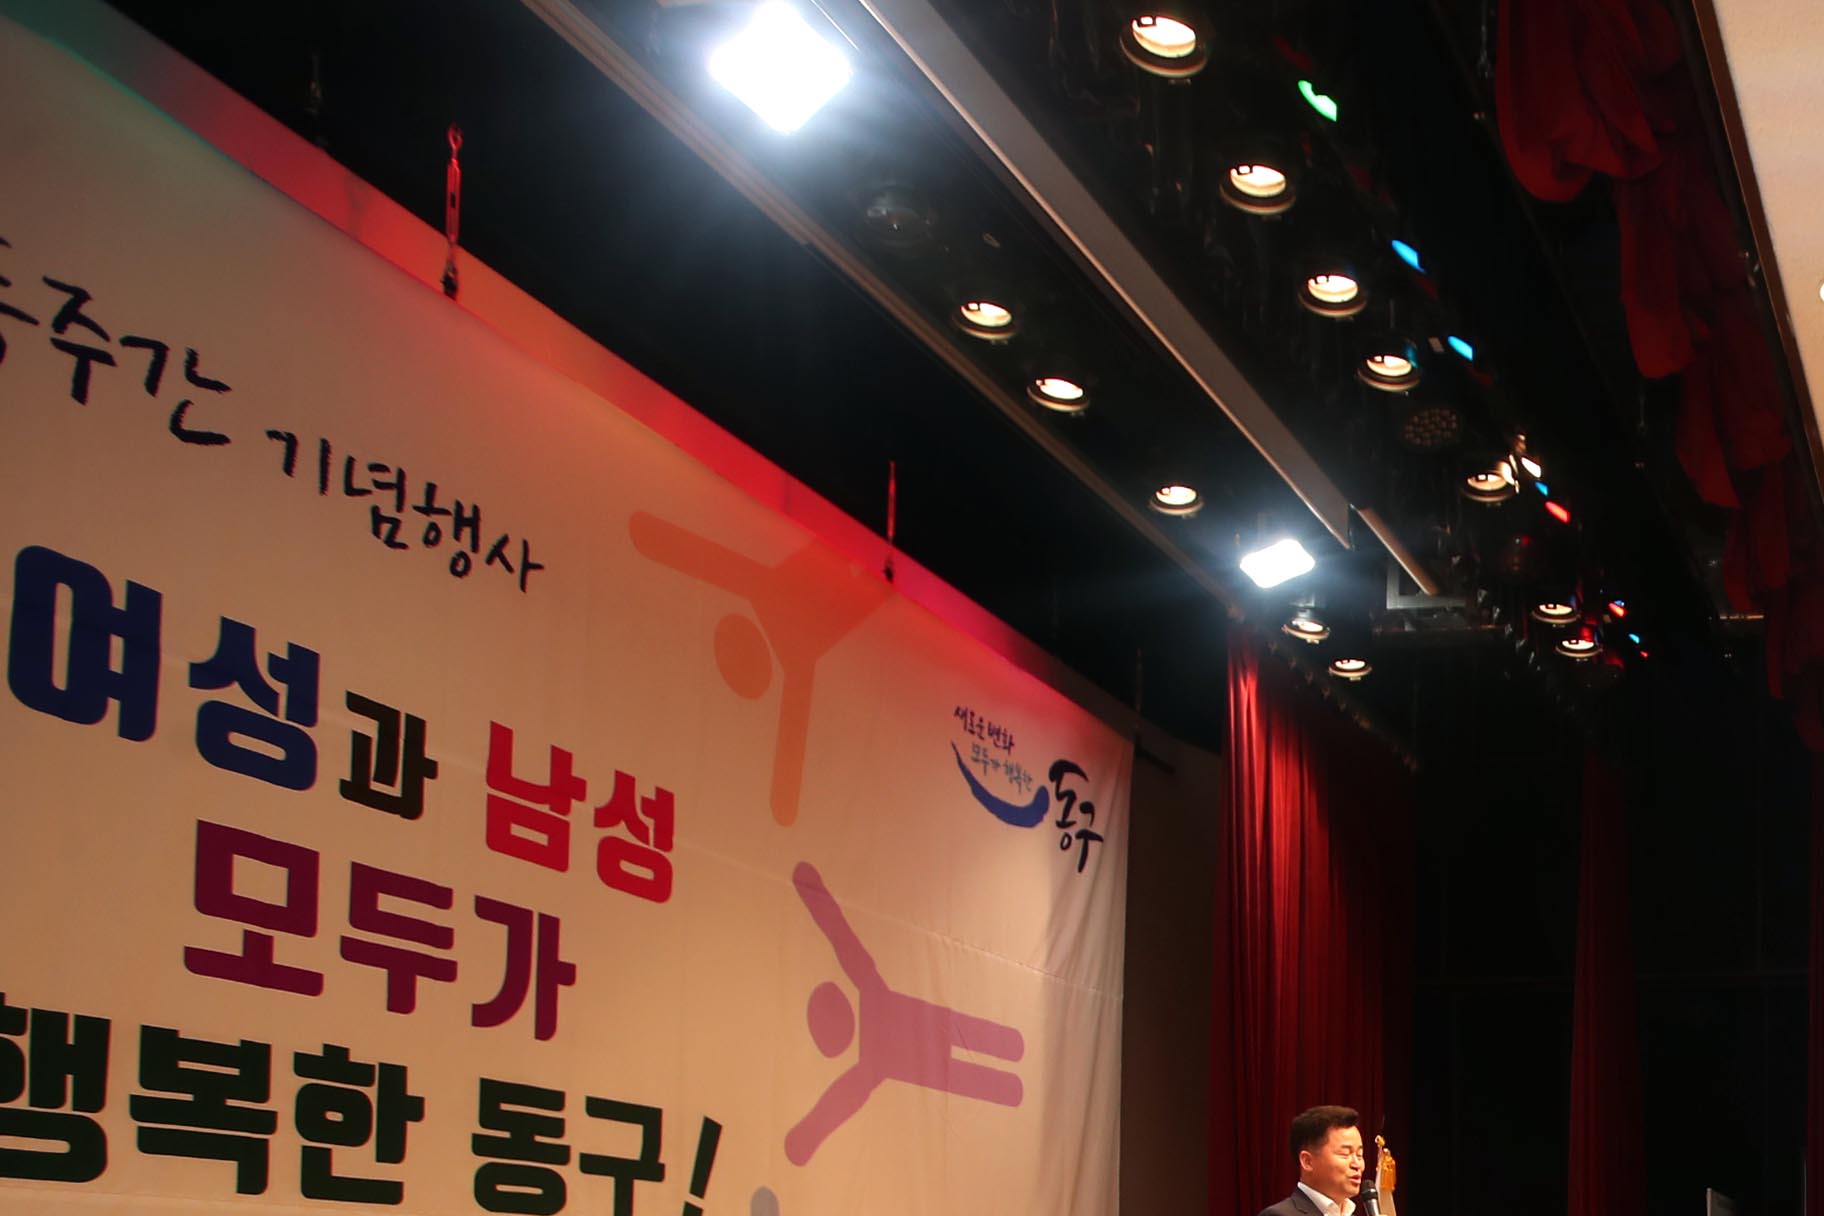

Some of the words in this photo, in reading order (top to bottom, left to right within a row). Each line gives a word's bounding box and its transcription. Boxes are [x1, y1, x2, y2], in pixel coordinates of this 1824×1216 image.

[266, 429, 545, 592] 기념행사
[7, 544, 439, 821] 여성과
[486, 720, 675, 904] 남성
[184, 818, 577, 1042] 모두가
[0, 991, 426, 1206] 행복한
